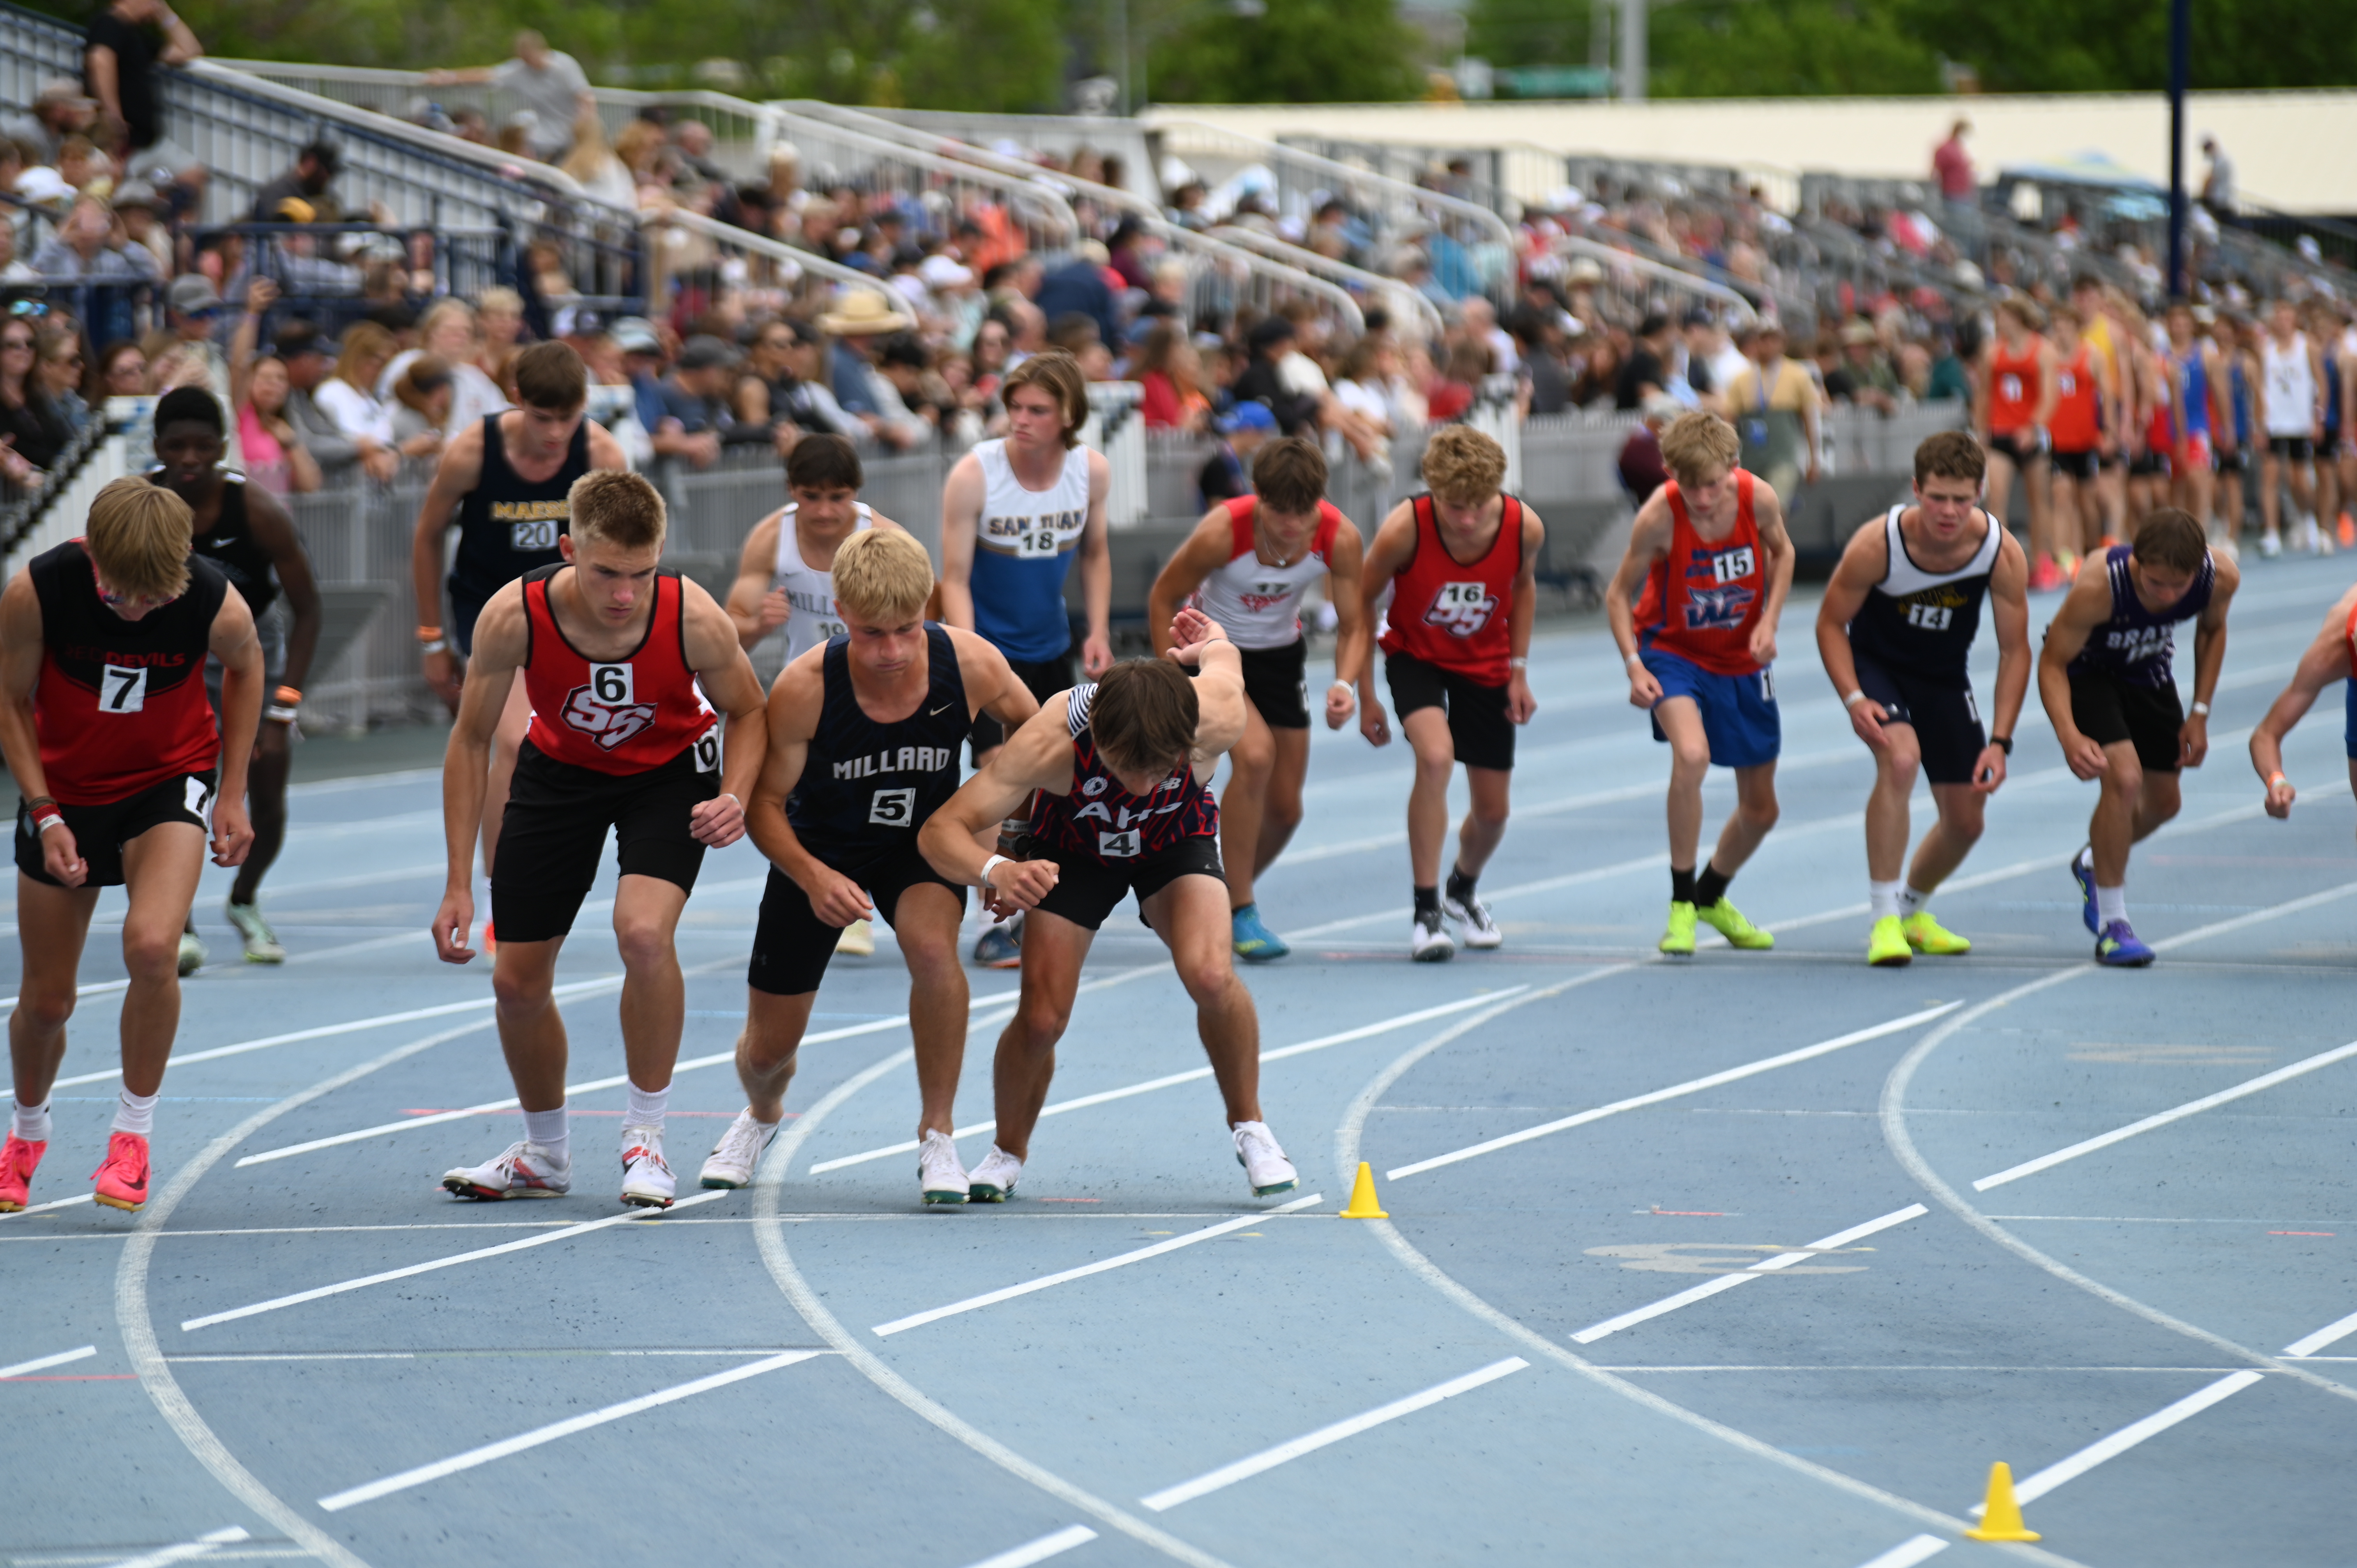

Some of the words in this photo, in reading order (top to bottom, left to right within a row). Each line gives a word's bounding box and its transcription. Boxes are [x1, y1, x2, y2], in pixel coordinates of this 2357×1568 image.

[492, 501, 571, 521] MAESE
[517, 523, 550, 546] 20
[990, 517, 1030, 535] SAN
[1023, 532, 1055, 551] 18
[1719, 552, 1748, 581] 15
[1257, 583, 1290, 593] 17
[1448, 586, 1481, 602] 16
[785, 588, 836, 616] MILL
[1915, 606, 1943, 625] 14
[110, 669, 140, 709] 7
[595, 667, 626, 702] 6
[833, 746, 950, 780] MILLARD
[875, 794, 906, 820] 5
[1104, 833, 1134, 855] 4
